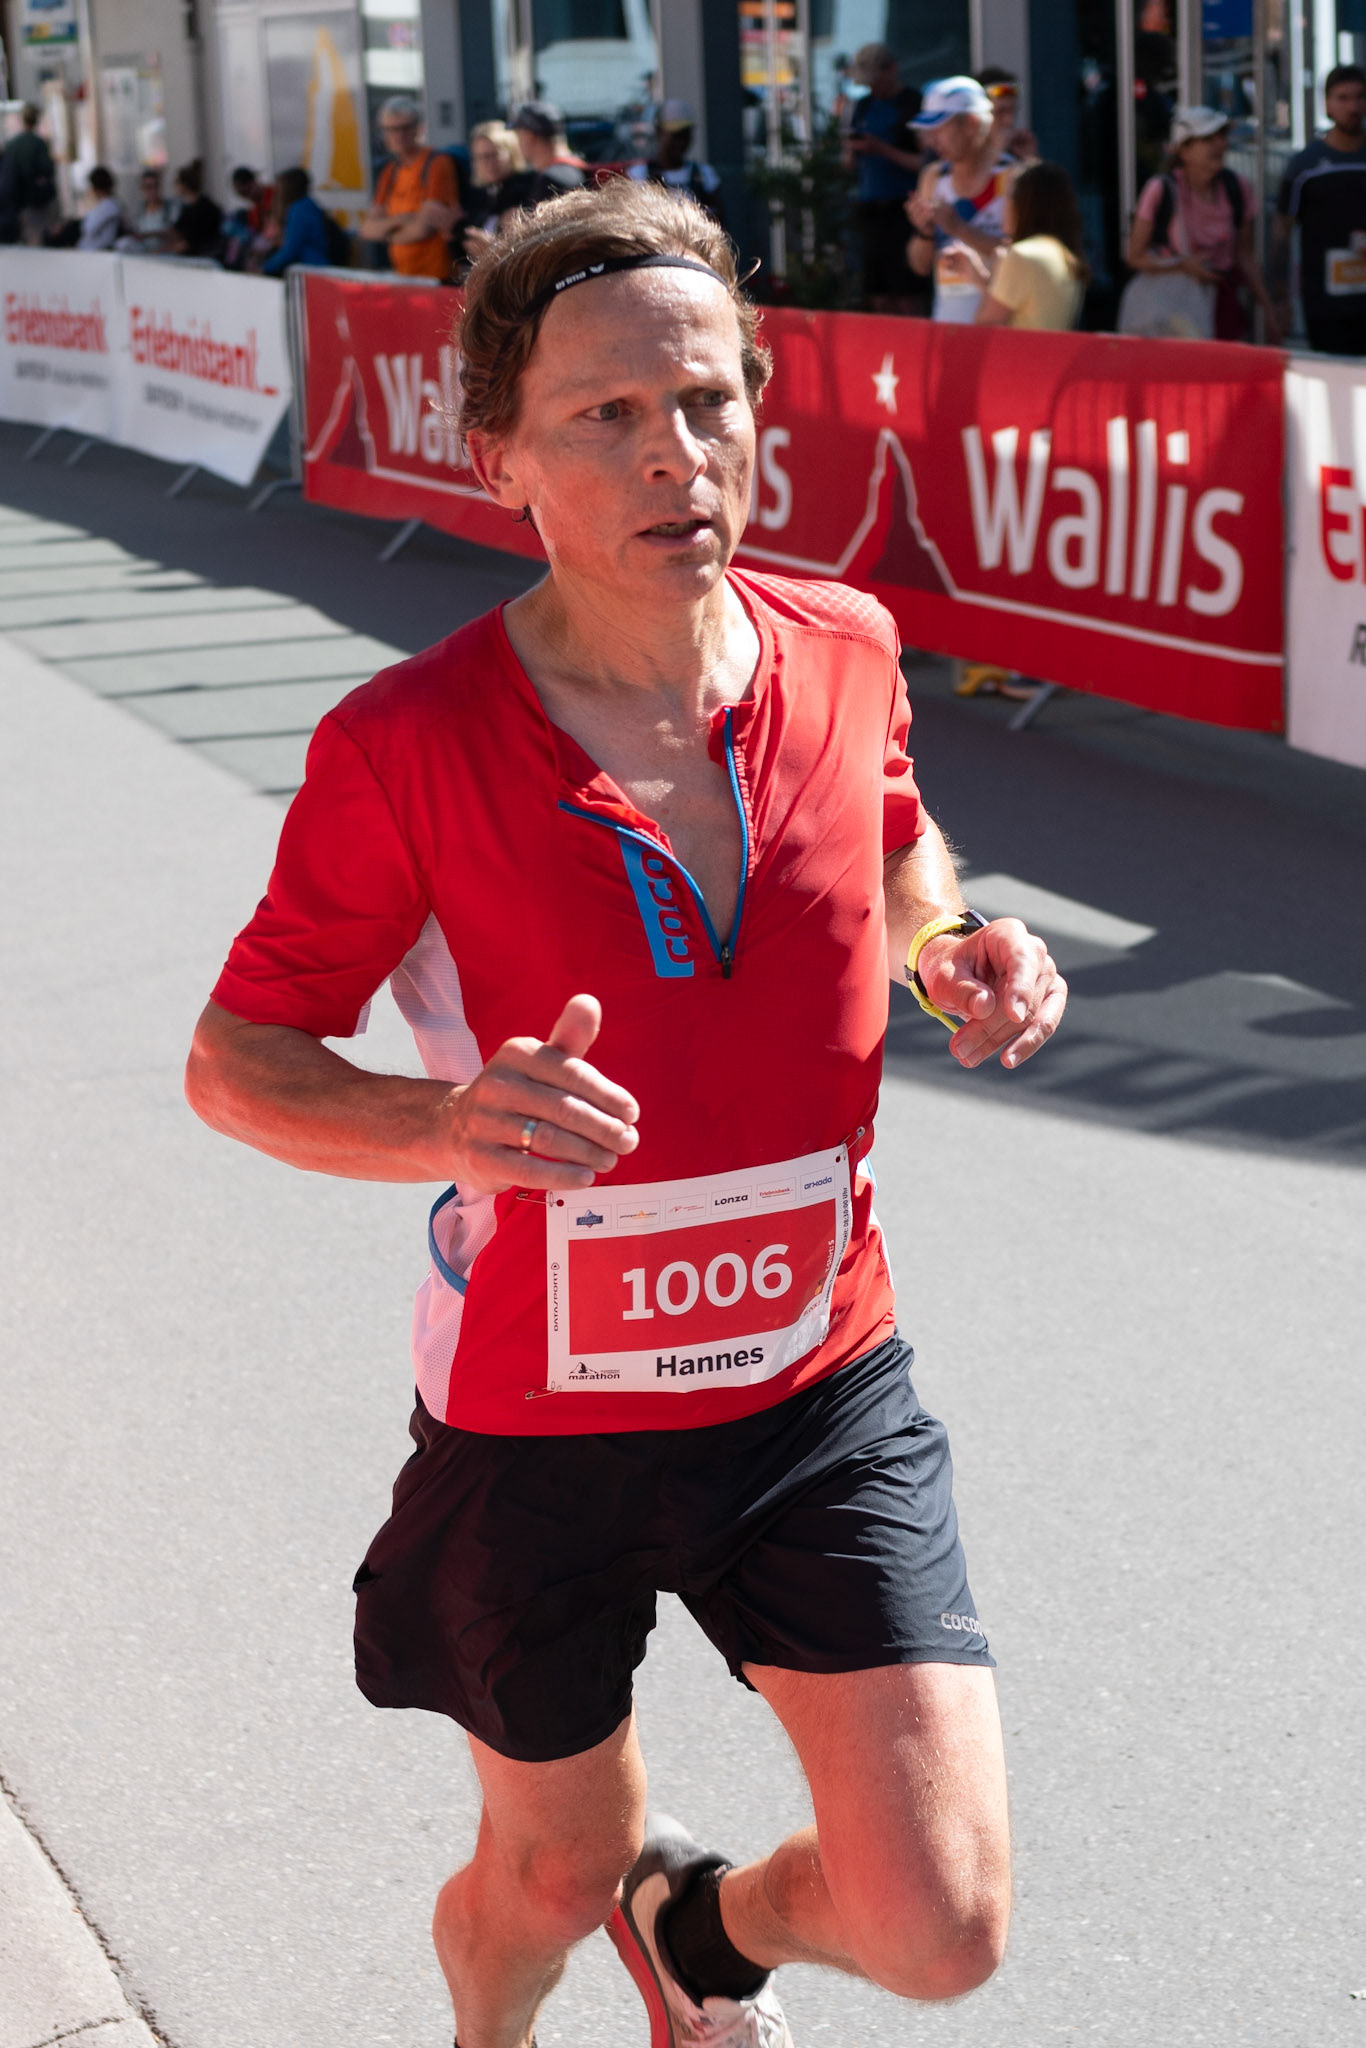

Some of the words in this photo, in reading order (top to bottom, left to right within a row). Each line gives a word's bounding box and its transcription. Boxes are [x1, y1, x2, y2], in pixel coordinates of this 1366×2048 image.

[374, 345, 471, 469] Wal
[962, 416, 1243, 617] Wallis
[622, 1243, 793, 1321] 1006
[568, 1372, 620, 1380] marathon
[656, 1346, 764, 1378] Hannes
